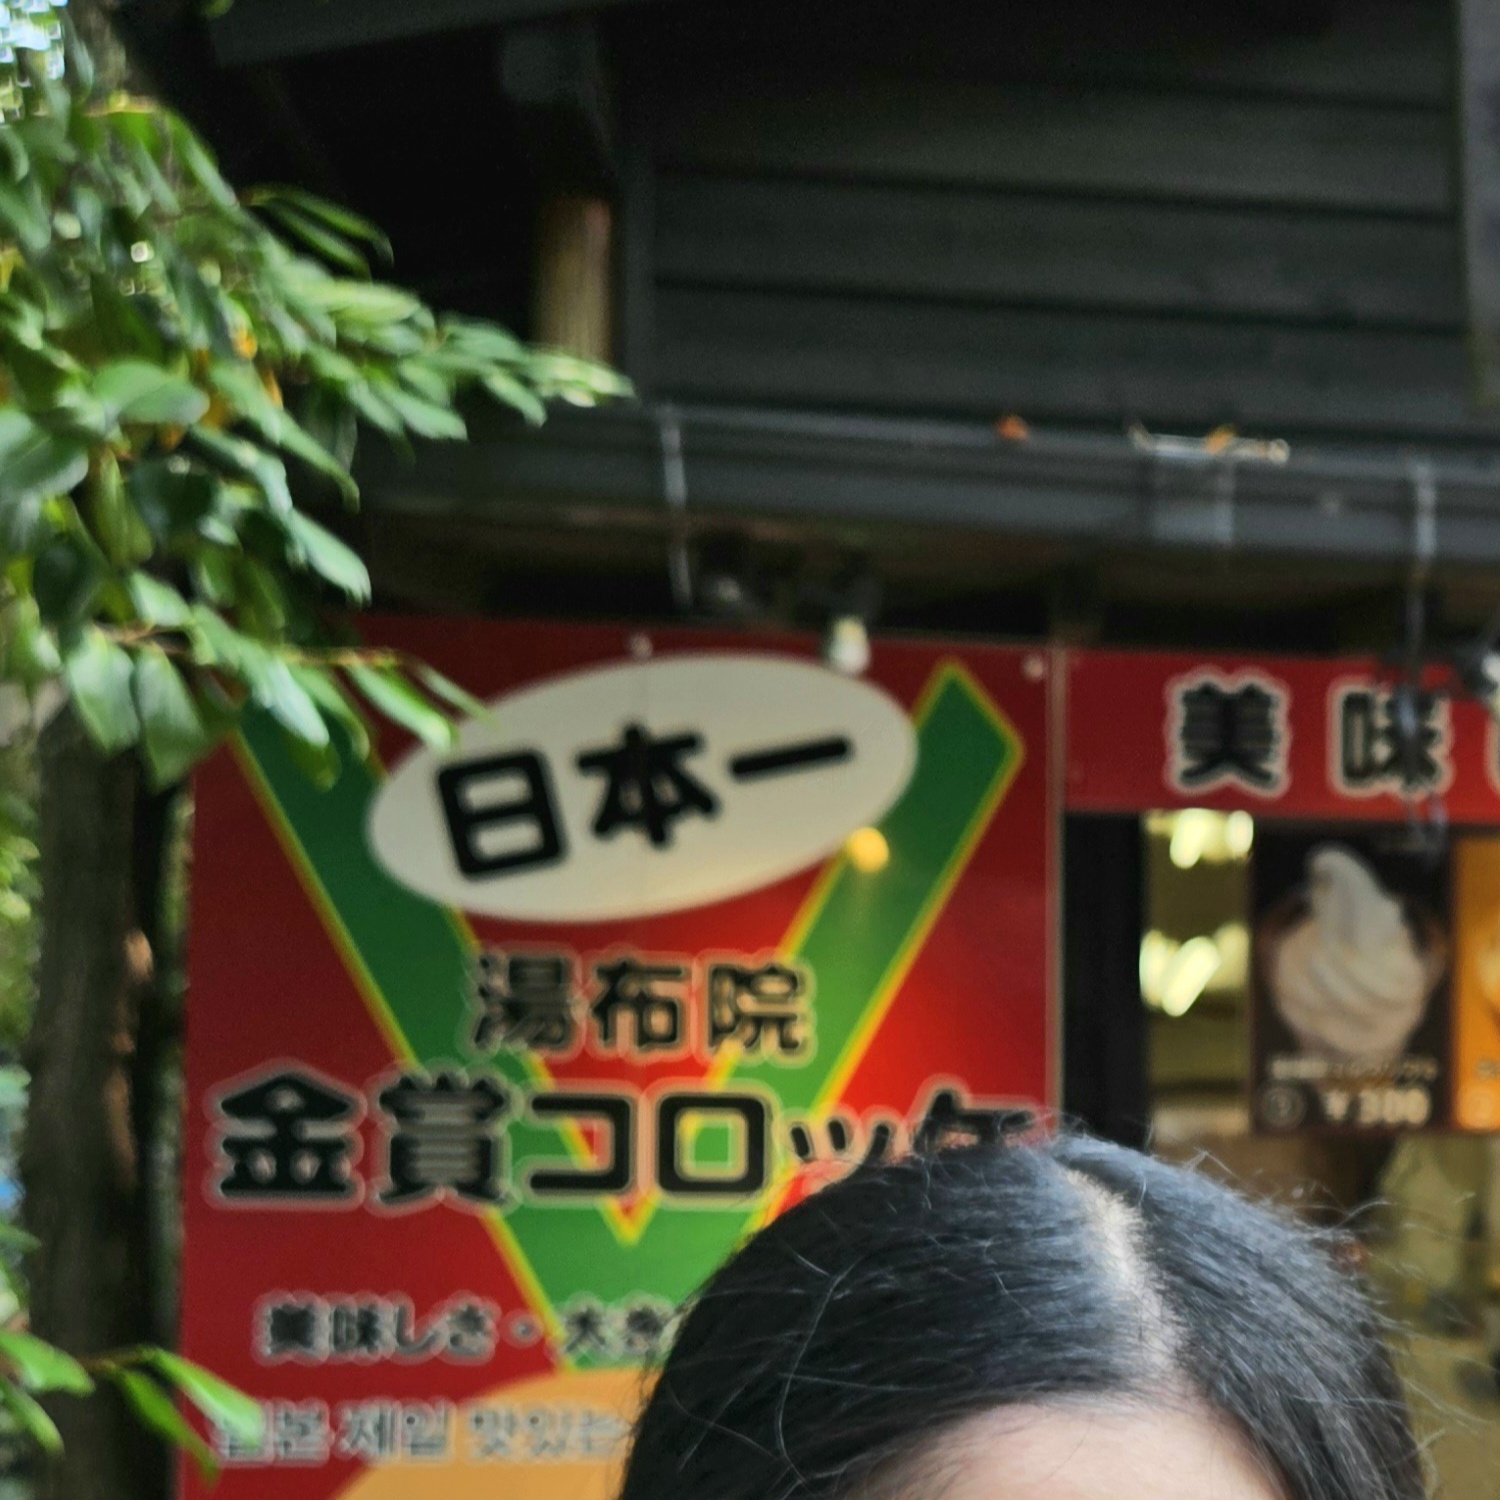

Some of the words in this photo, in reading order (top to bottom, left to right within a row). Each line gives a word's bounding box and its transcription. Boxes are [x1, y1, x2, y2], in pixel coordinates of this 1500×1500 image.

[436, 718, 854, 882] 日本一
[472, 953, 812, 1053] 湯布院
